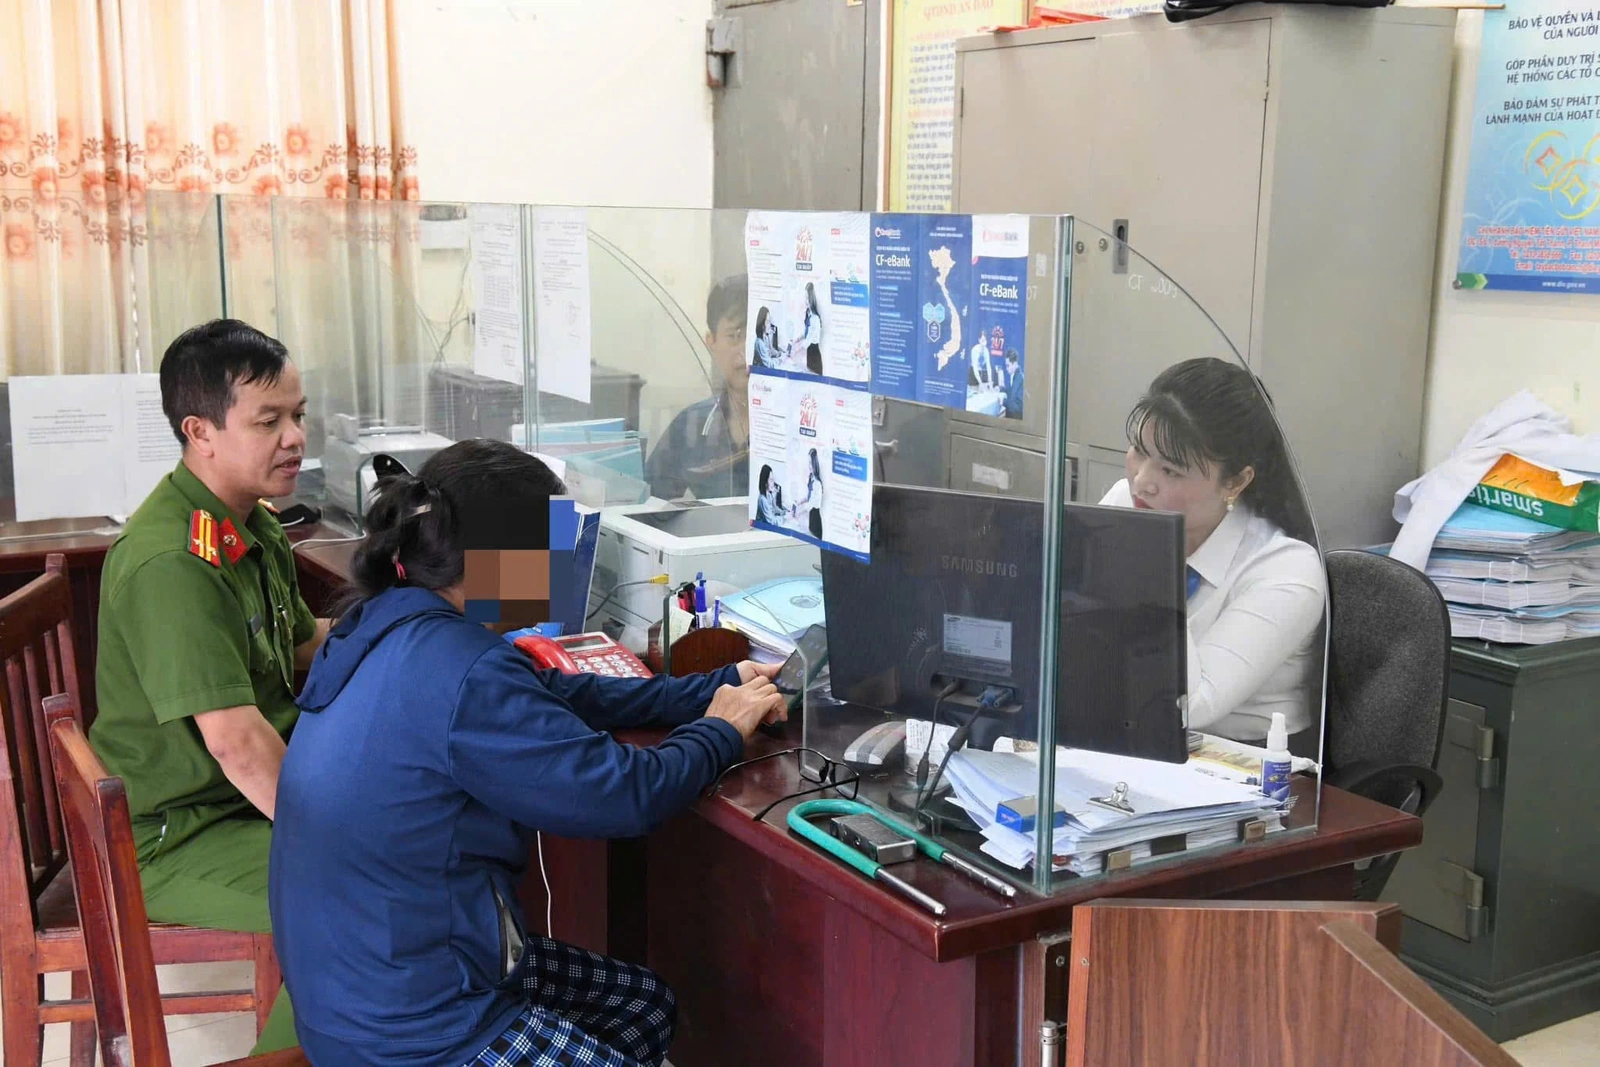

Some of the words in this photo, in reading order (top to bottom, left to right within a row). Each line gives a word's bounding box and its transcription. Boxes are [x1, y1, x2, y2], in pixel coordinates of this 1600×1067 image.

[1508, 16, 1528, 30] BẢO
[1531, 15, 1542, 28] VỆ
[1545, 10, 1578, 26] QUYỀN
[1581, 9, 1594, 22] VÀ
[1544, 27, 1563, 40] CỦA
[1567, 23, 1599, 38] NGƯỜI
[1528, 55, 1555, 69] PHẦN
[1557, 56, 1577, 67] DUY
[1507, 73, 1519, 86] HỆ
[1522, 69, 1554, 83] THỐNG
[1557, 68, 1576, 80] CÁC
[1579, 63, 1593, 78] TỔ
[1503, 98, 1523, 111] BẢO
[1551, 97, 1564, 110] SỰ
[1566, 95, 1592, 107] PHÁT
[1512, 114, 1541, 126] MẠNH
[1544, 110, 1564, 122] CỦA
[1567, 110, 1594, 123] HOẠT
[875, 254, 911, 268] CF-eBank
[979, 283, 1018, 299] CF-eBank
[941, 555, 1019, 578] SAMSUNG
